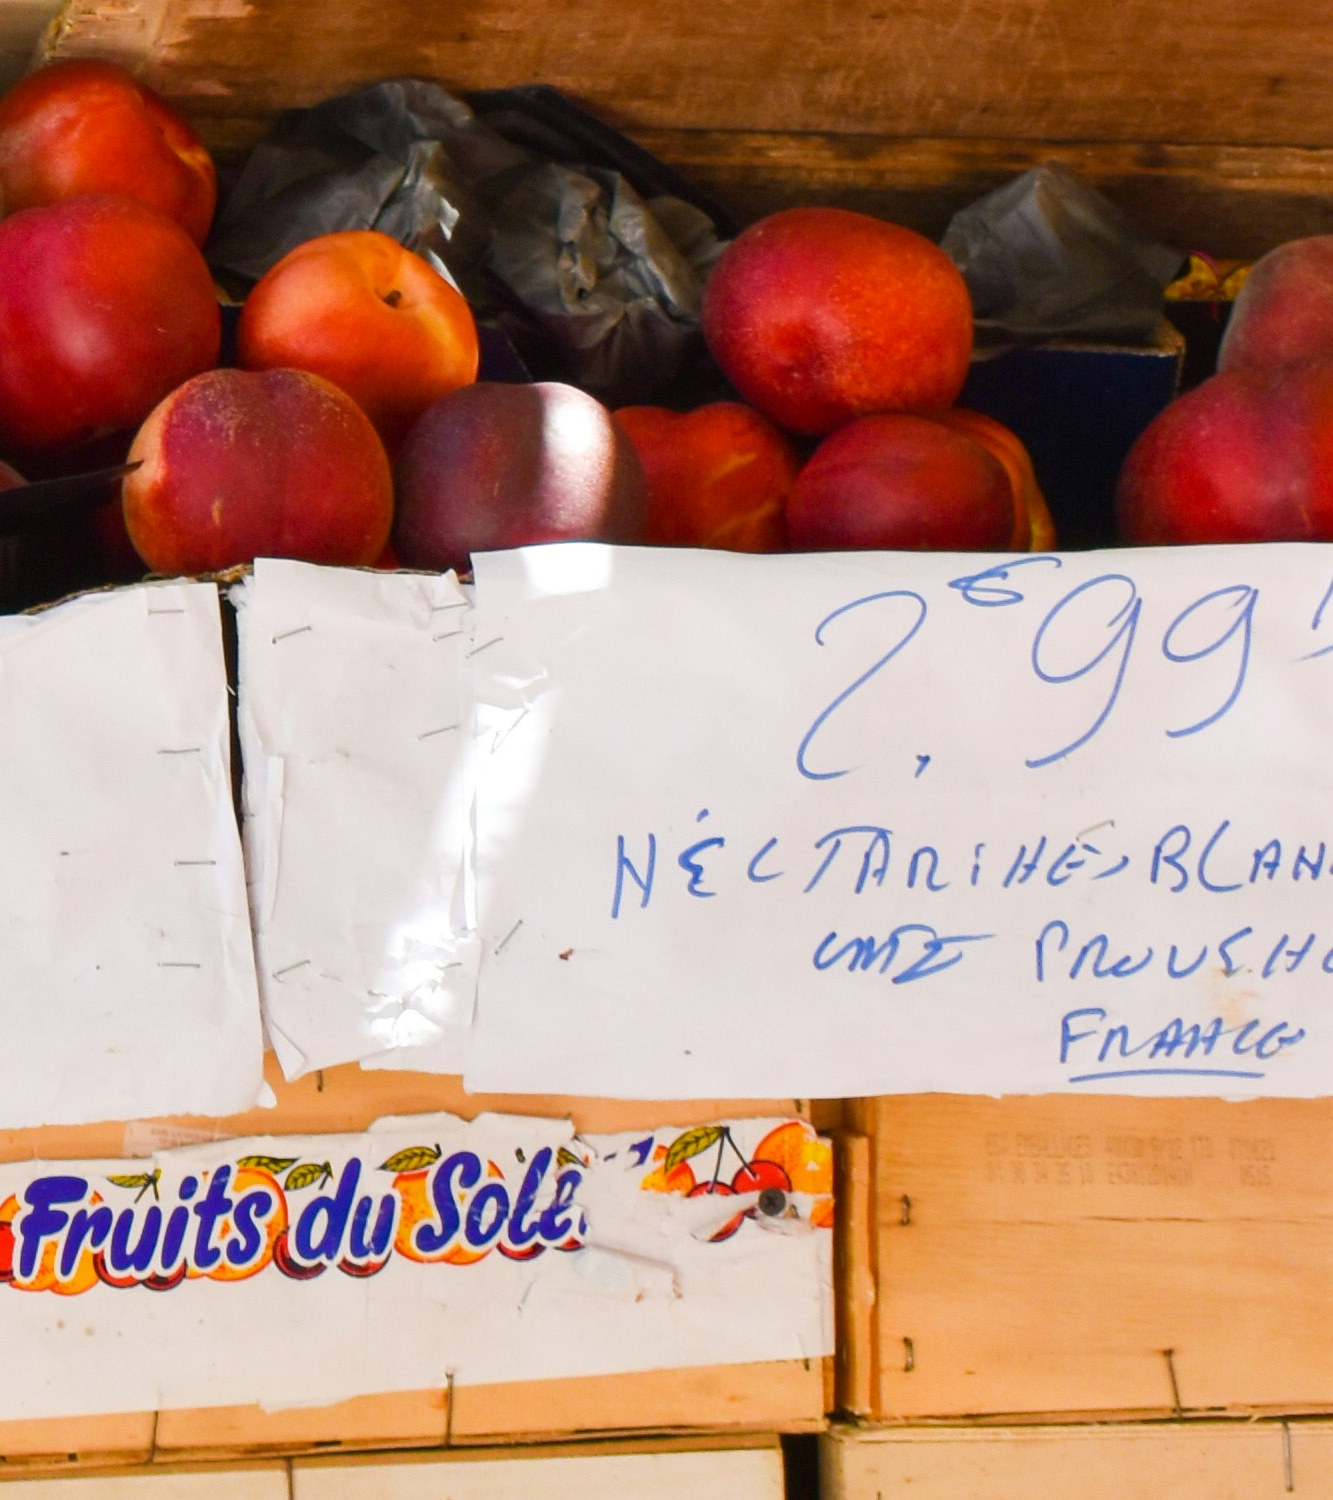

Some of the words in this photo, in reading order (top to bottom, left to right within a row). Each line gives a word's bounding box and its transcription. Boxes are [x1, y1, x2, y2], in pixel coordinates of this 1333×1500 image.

[1034, 919, 1333, 983] PROVEN
[10, 1162, 270, 1284] Fruits
[284, 1156, 393, 1272] du
